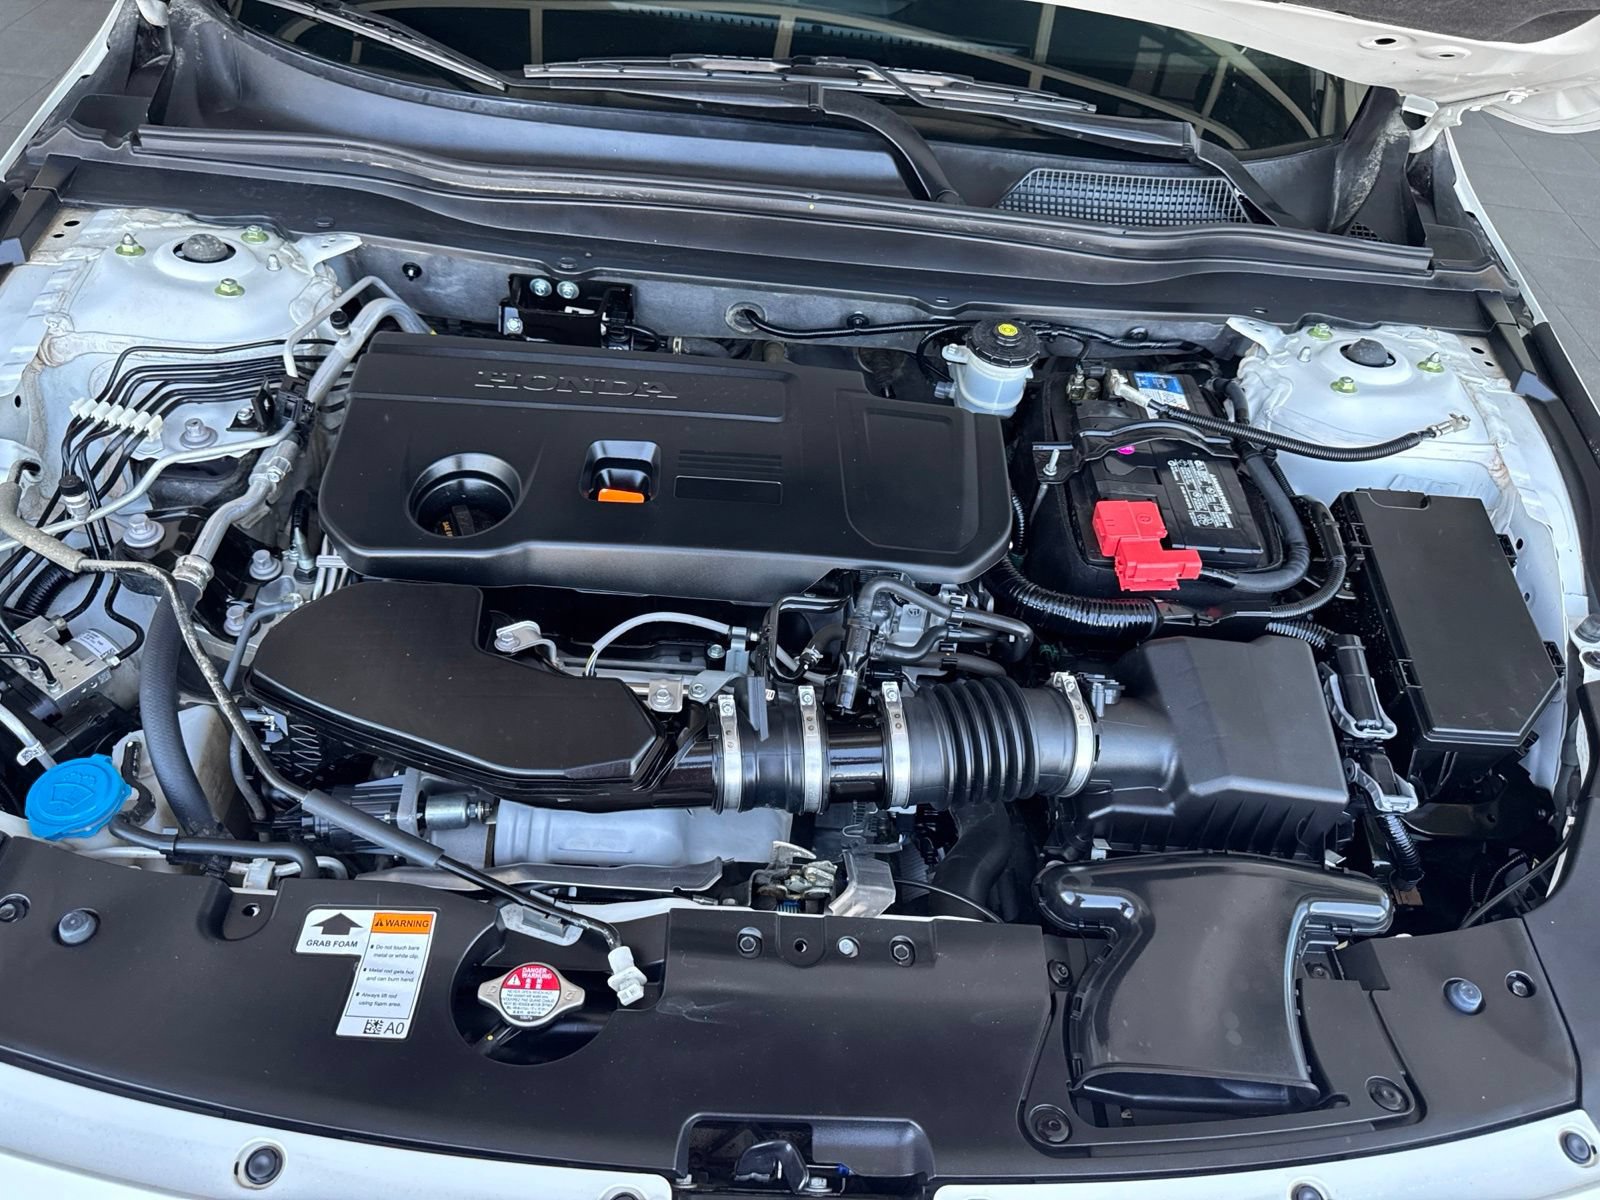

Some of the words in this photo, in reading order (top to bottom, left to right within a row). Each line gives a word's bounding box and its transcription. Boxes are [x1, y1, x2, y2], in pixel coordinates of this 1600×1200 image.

[474, 371, 678, 399] HONDA
[385, 919, 430, 928] WARNING
[306, 939, 331, 948] GRAB
[333, 940, 358, 948] FOAM
[383, 1021, 405, 1035] A0
